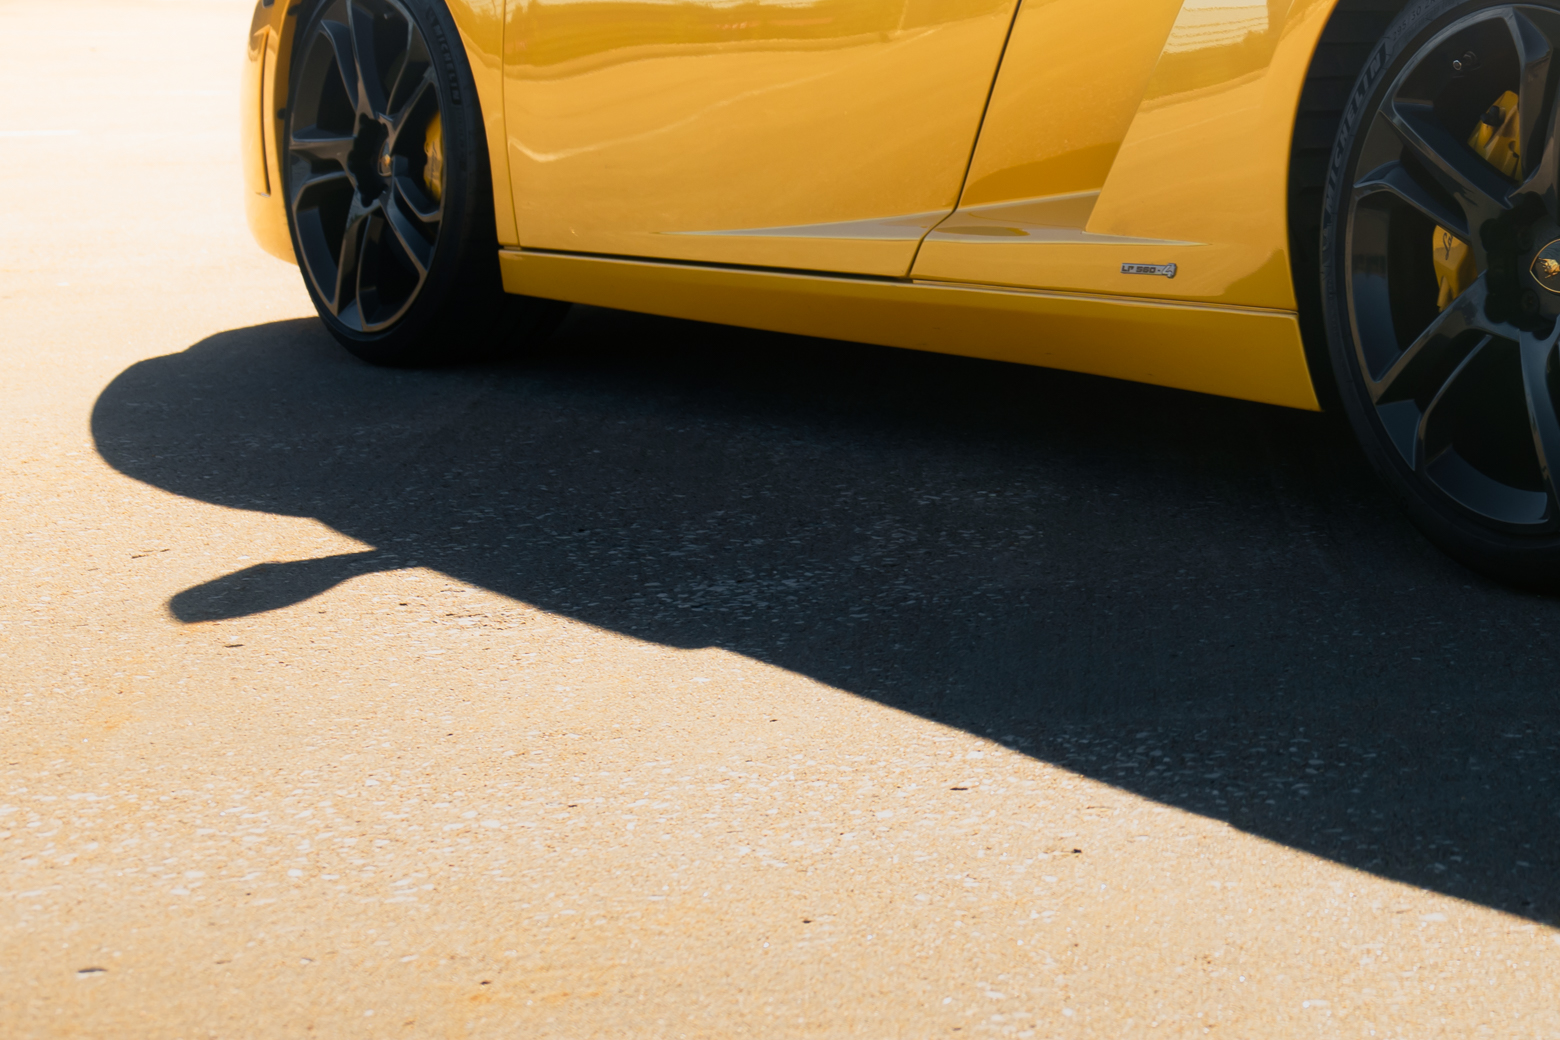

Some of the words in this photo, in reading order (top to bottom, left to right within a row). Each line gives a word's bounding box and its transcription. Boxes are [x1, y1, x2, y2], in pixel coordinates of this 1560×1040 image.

[434, 24, 461, 101] MICHELIN
[1325, 51, 1382, 215] MICHELIN
[1121, 265, 1135, 273] LP
